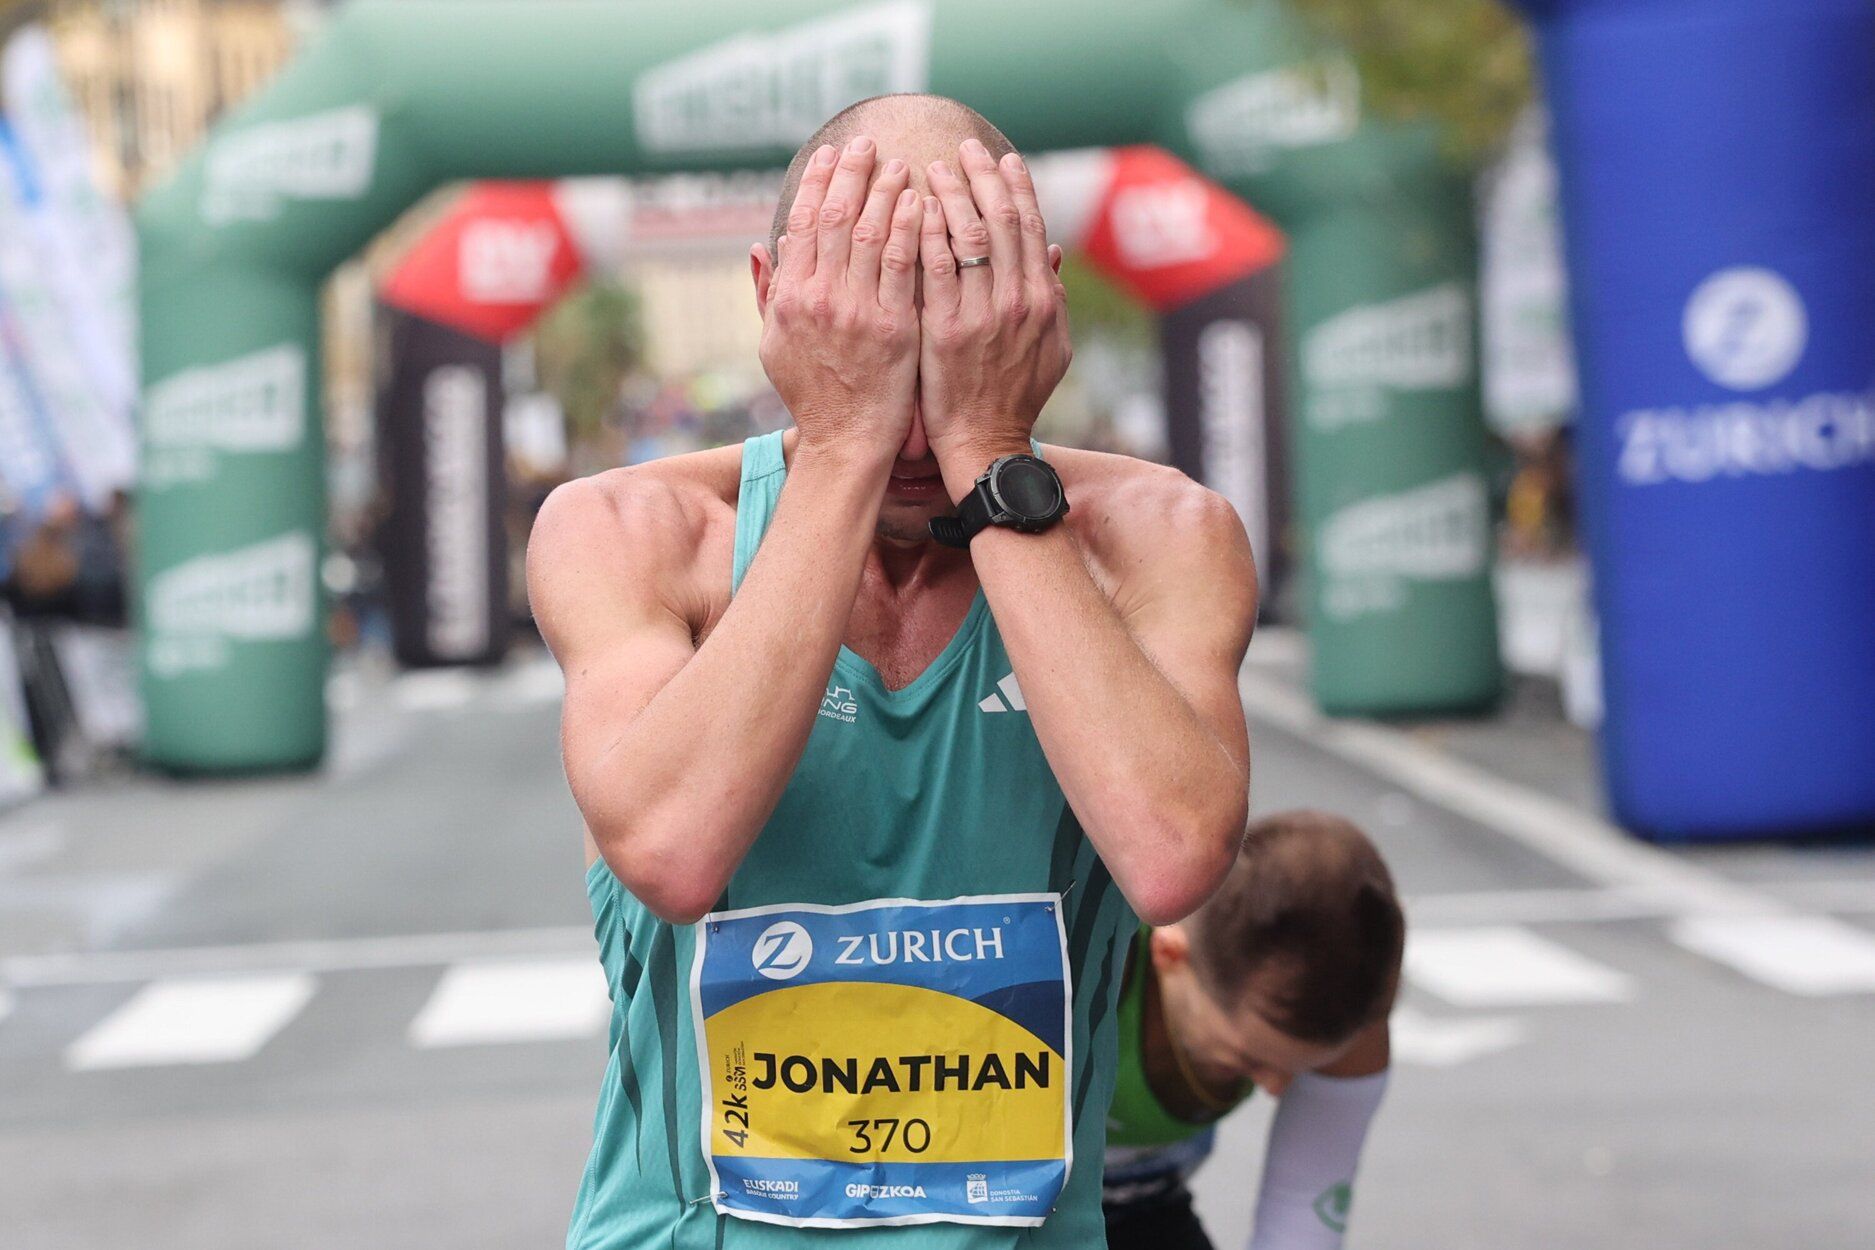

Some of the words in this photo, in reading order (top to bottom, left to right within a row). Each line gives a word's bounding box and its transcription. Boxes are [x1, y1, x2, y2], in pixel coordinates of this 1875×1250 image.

[817, 708, 857, 723] ORDEAUX
[834, 926, 1006, 965] ZURICH
[752, 1051, 1050, 1094] JONATHAN
[722, 1092, 749, 1148] 42k
[848, 1118, 931, 1154] 370
[743, 1178, 799, 1193] EUSKADI
[845, 1183, 928, 1199] GIPUZKOA
[989, 1188, 1021, 1196] DONOSTIA
[990, 1195, 1004, 1203] SAN
[1004, 1194, 1039, 1202] SEBASTIÁN
